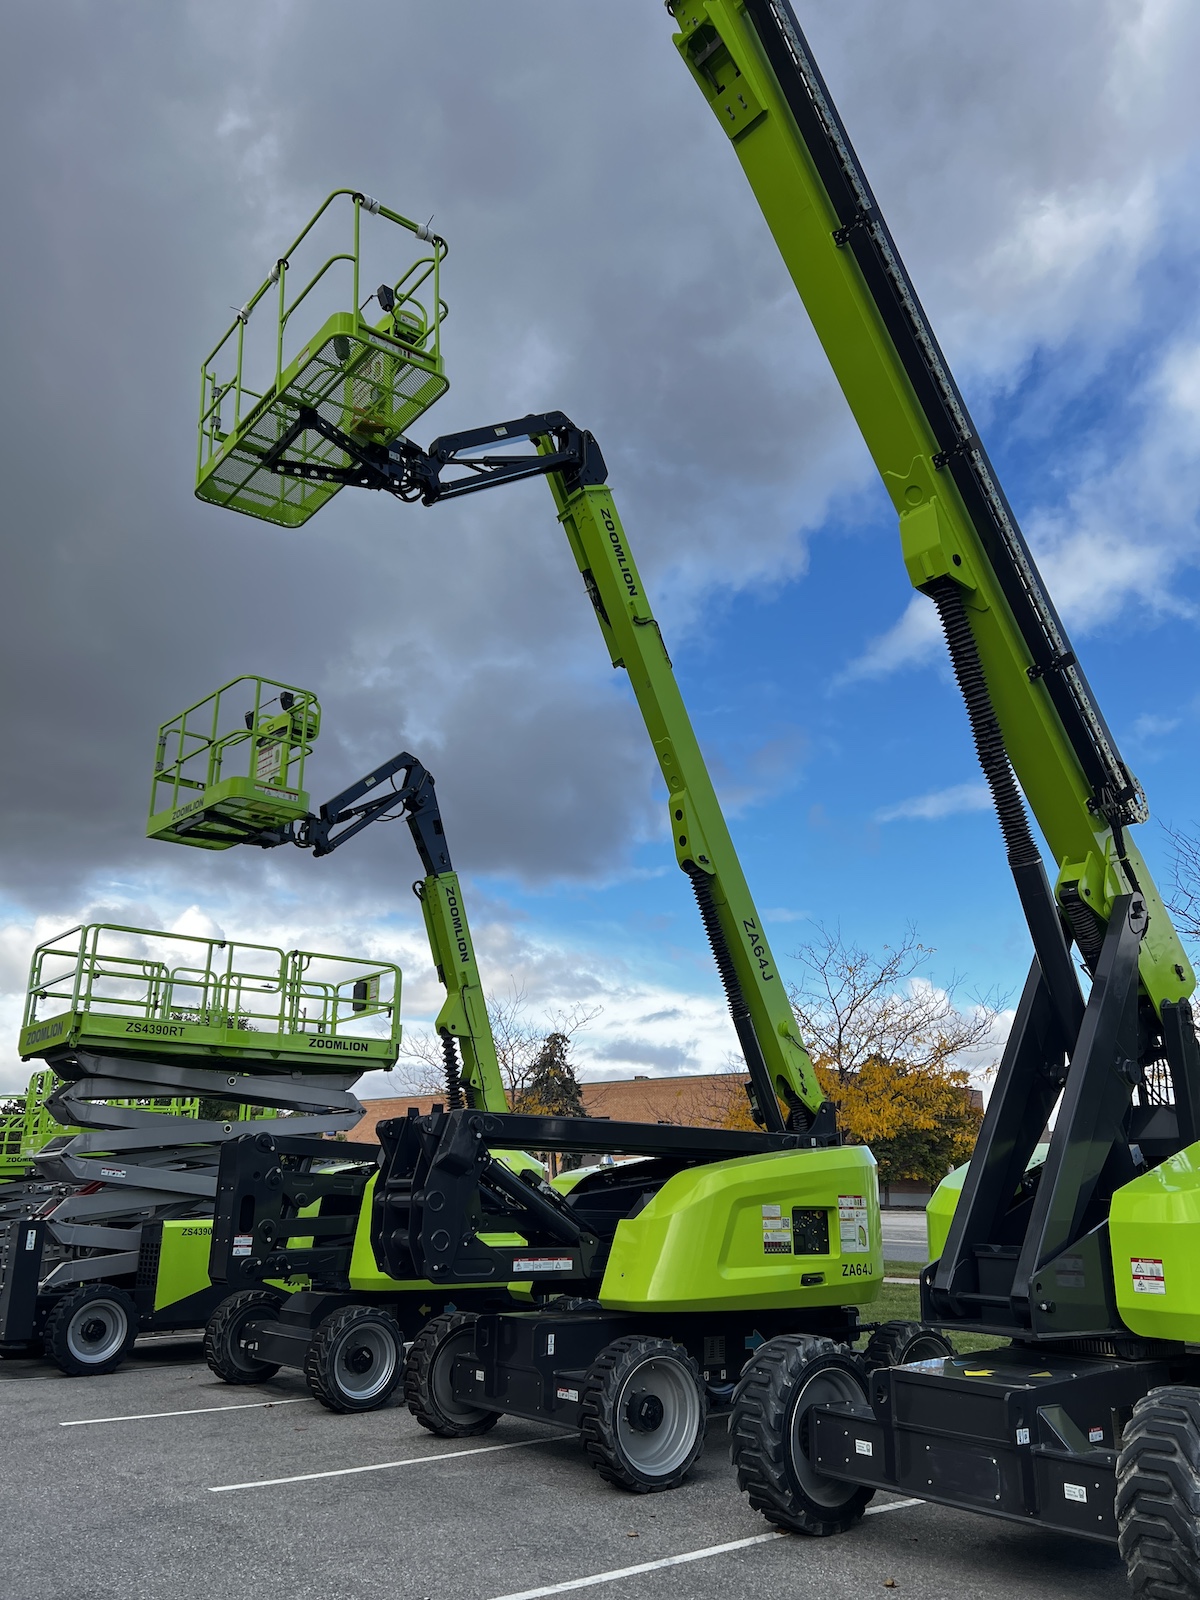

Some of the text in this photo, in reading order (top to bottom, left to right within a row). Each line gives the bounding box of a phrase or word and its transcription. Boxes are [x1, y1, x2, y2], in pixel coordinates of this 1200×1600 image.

[600, 508, 638, 597] ZOOMLION
[171, 798, 204, 820] ZOOMLION
[445, 886, 470, 963] ZOOMLION
[743, 917, 774, 981] ZA64J
[25, 1021, 64, 1046] ZOOMLION
[125, 1022, 185, 1036] ZS4390RT
[308, 1038, 368, 1052] ZOOMLION
[181, 1227, 213, 1236] ZS4390
[841, 1263, 873, 1277] ZA64J
